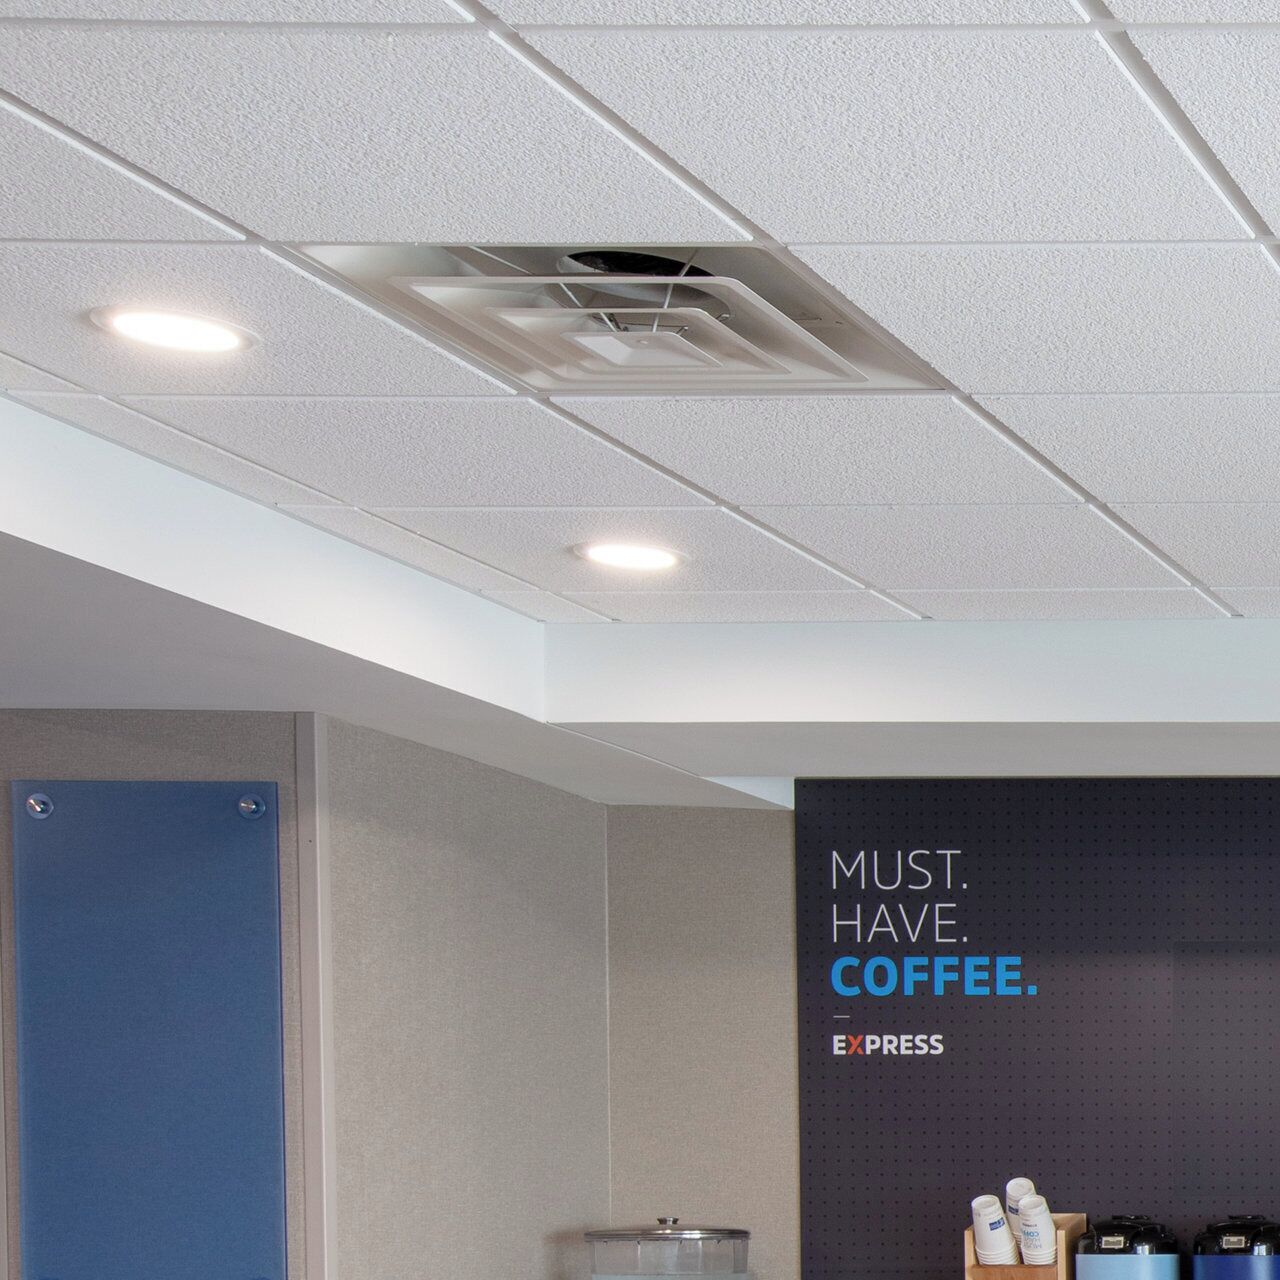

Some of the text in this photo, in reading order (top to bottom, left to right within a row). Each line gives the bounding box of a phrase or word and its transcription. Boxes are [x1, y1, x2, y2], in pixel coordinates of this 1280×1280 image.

[832, 849, 968, 890] MUST.
[832, 903, 968, 943] HAVE.
[830, 955, 1038, 997] COFFEE.
[832, 1034, 945, 1056] EXPRESS
